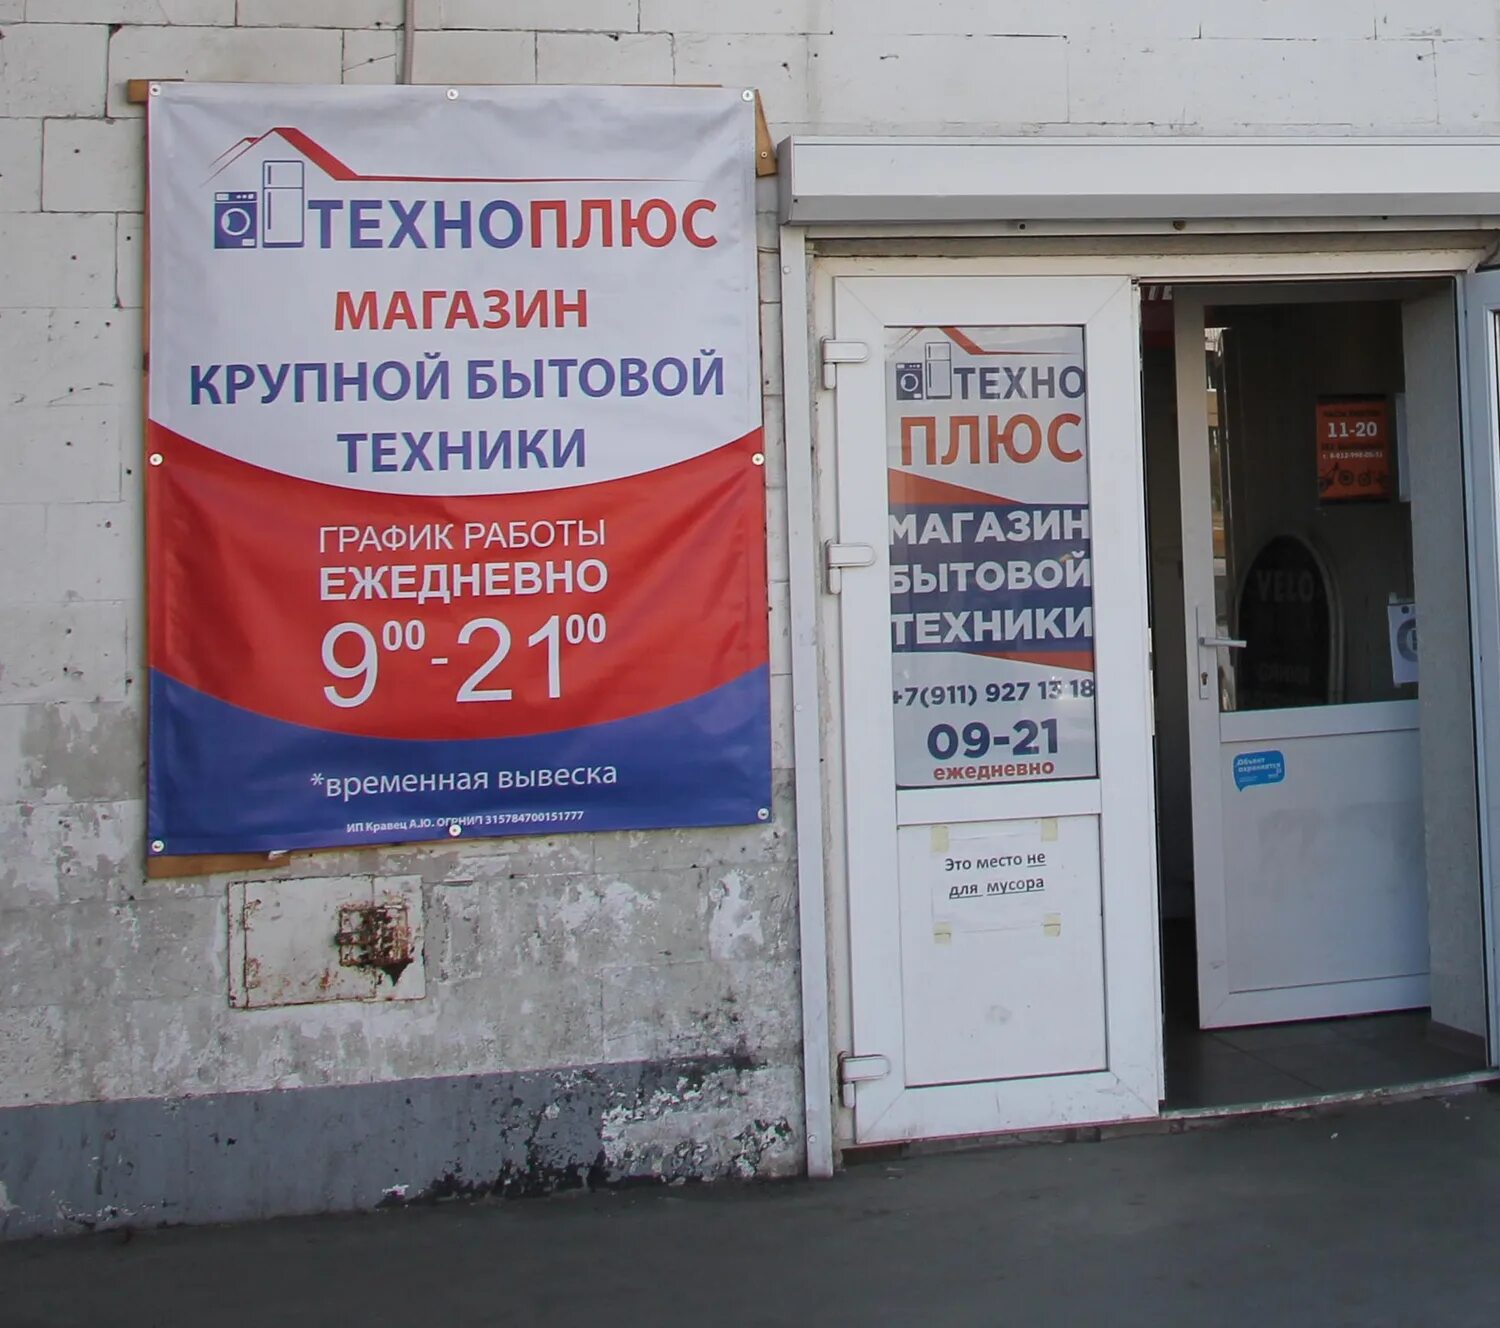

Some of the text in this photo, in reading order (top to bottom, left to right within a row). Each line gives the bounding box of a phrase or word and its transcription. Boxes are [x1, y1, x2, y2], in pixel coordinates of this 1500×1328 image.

[308, 198, 719, 250] ТЕХНОПЛЮС
[333, 288, 589, 331] МАГАЗИН
[190, 348, 725, 406] КРУПНОЙ БЫТОВОЙ
[954, 365, 1086, 401] ТЕХНО
[901, 413, 1084, 466] ПЛЮС
[1327, 421, 1378, 438] 11-20
[336, 428, 587, 474] ТЕХНИКИ
[319, 518, 607, 553] ГРАФИК РАБОТЫ
[889, 509, 1090, 546] МАГАЗИН
[319, 558, 609, 605] ЕЖЕДНЕВНО
[890, 550, 1091, 595] БЫТОВОЙ
[890, 606, 1093, 646] ТЕХНИКИ
[985, 682, 1031, 703] 927
[1069, 678, 1094, 698] 18
[926, 717, 1059, 761] 09-21
[499, 765, 617, 789] вывеска
[933, 760, 1055, 782] ежедневно
[347, 823, 364, 833] ИП
[366, 821, 408, 834] Кравец
[410, 819, 435, 829] А.Ю.
[945, 852, 1046, 872] Это место не
[949, 877, 1045, 899] для мусора
